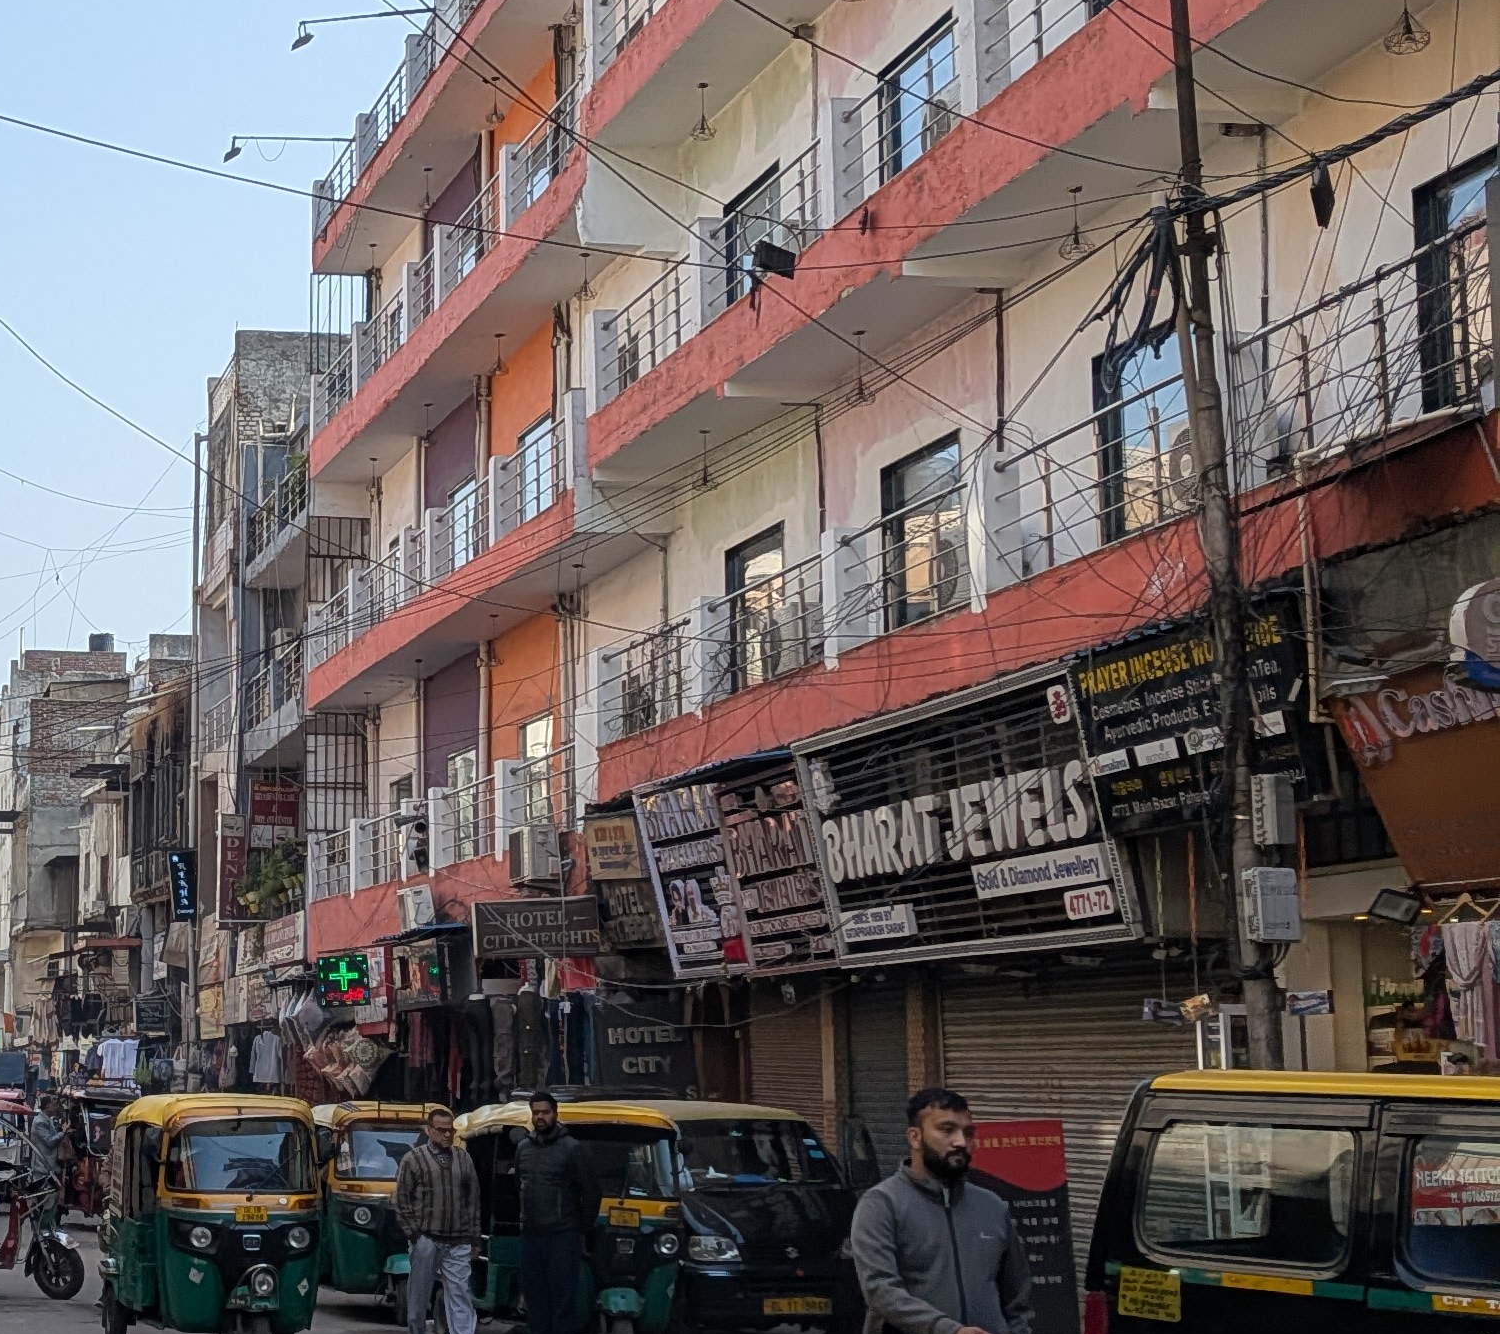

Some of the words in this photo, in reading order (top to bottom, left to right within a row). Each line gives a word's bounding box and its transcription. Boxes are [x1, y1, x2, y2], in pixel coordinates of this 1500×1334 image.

[1078, 658, 1128, 699] PRAYER
[1128, 642, 1191, 684] INCENSE
[1144, 683, 1185, 707] Incense
[1103, 717, 1151, 744] Ayurvedic
[822, 794, 941, 884] BHARAT
[945, 759, 1089, 861] JEWELS
[726, 812, 815, 878] BHARAT
[977, 867, 1000, 892] Gold
[1000, 867, 1008, 887] &
[1008, 859, 1052, 887] Diamond
[1052, 854, 1101, 880] Jewellery
[1069, 890, 1111, 916] 4771-72
[505, 908, 569, 928] HOTEL
[483, 929, 523, 951] CITY
[526, 927, 601, 949] HEIGHTS
[608, 1025, 683, 1045] HOTEL
[621, 1056, 671, 1075] CITY
